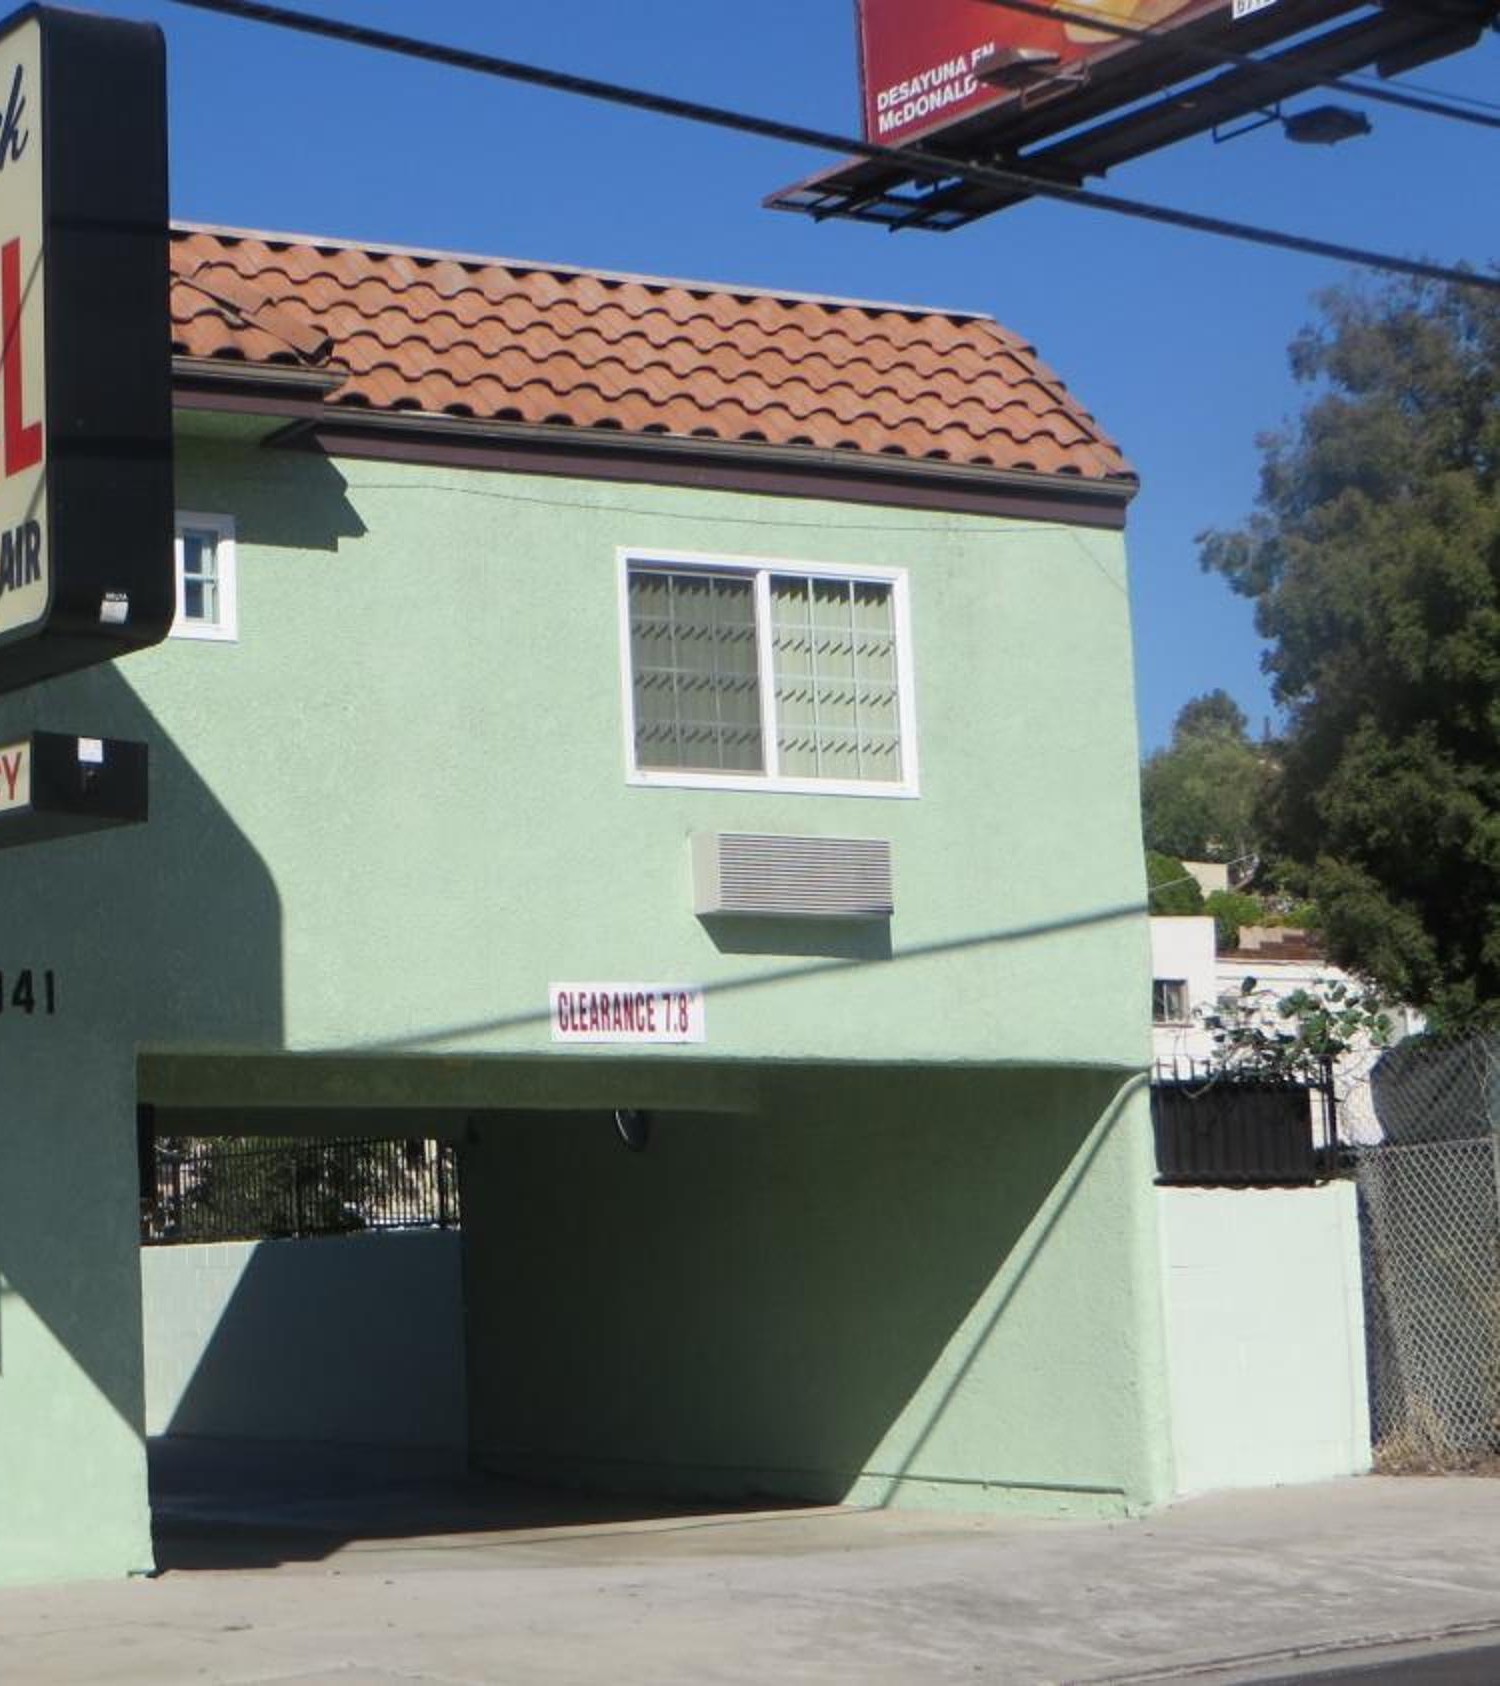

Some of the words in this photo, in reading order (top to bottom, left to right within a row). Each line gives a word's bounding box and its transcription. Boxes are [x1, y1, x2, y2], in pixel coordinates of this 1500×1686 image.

[877, 55, 968, 112] DESAYUNA
[878, 73, 988, 134] McDONALD
[0, 519, 42, 593] AIR
[557, 991, 656, 1032] CLEARANCE
